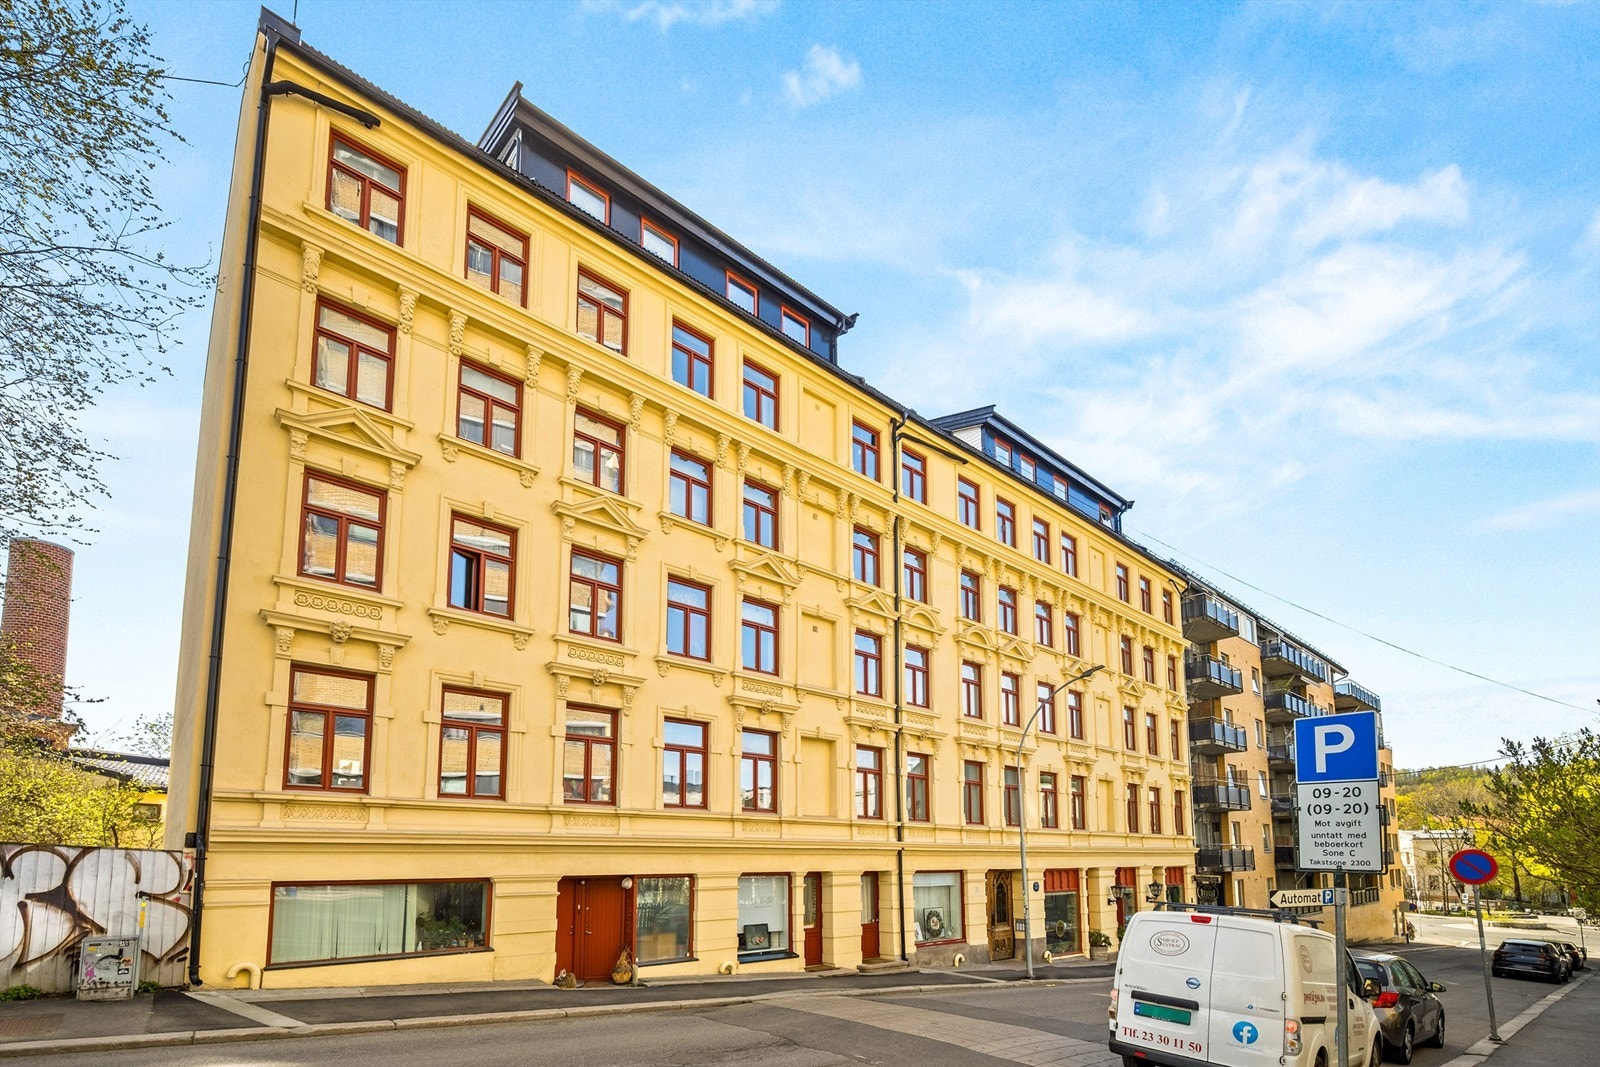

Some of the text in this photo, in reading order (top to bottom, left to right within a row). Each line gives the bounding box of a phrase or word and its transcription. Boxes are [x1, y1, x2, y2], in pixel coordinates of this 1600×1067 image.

[1314, 724, 1355, 773] P
[1335, 819, 1362, 828] avgift
[1322, 849, 1356, 857] Sone C
[1280, 891, 1332, 905] Automat P
[1122, 1026, 1202, 1053] Tlf. 23 30 11 50
